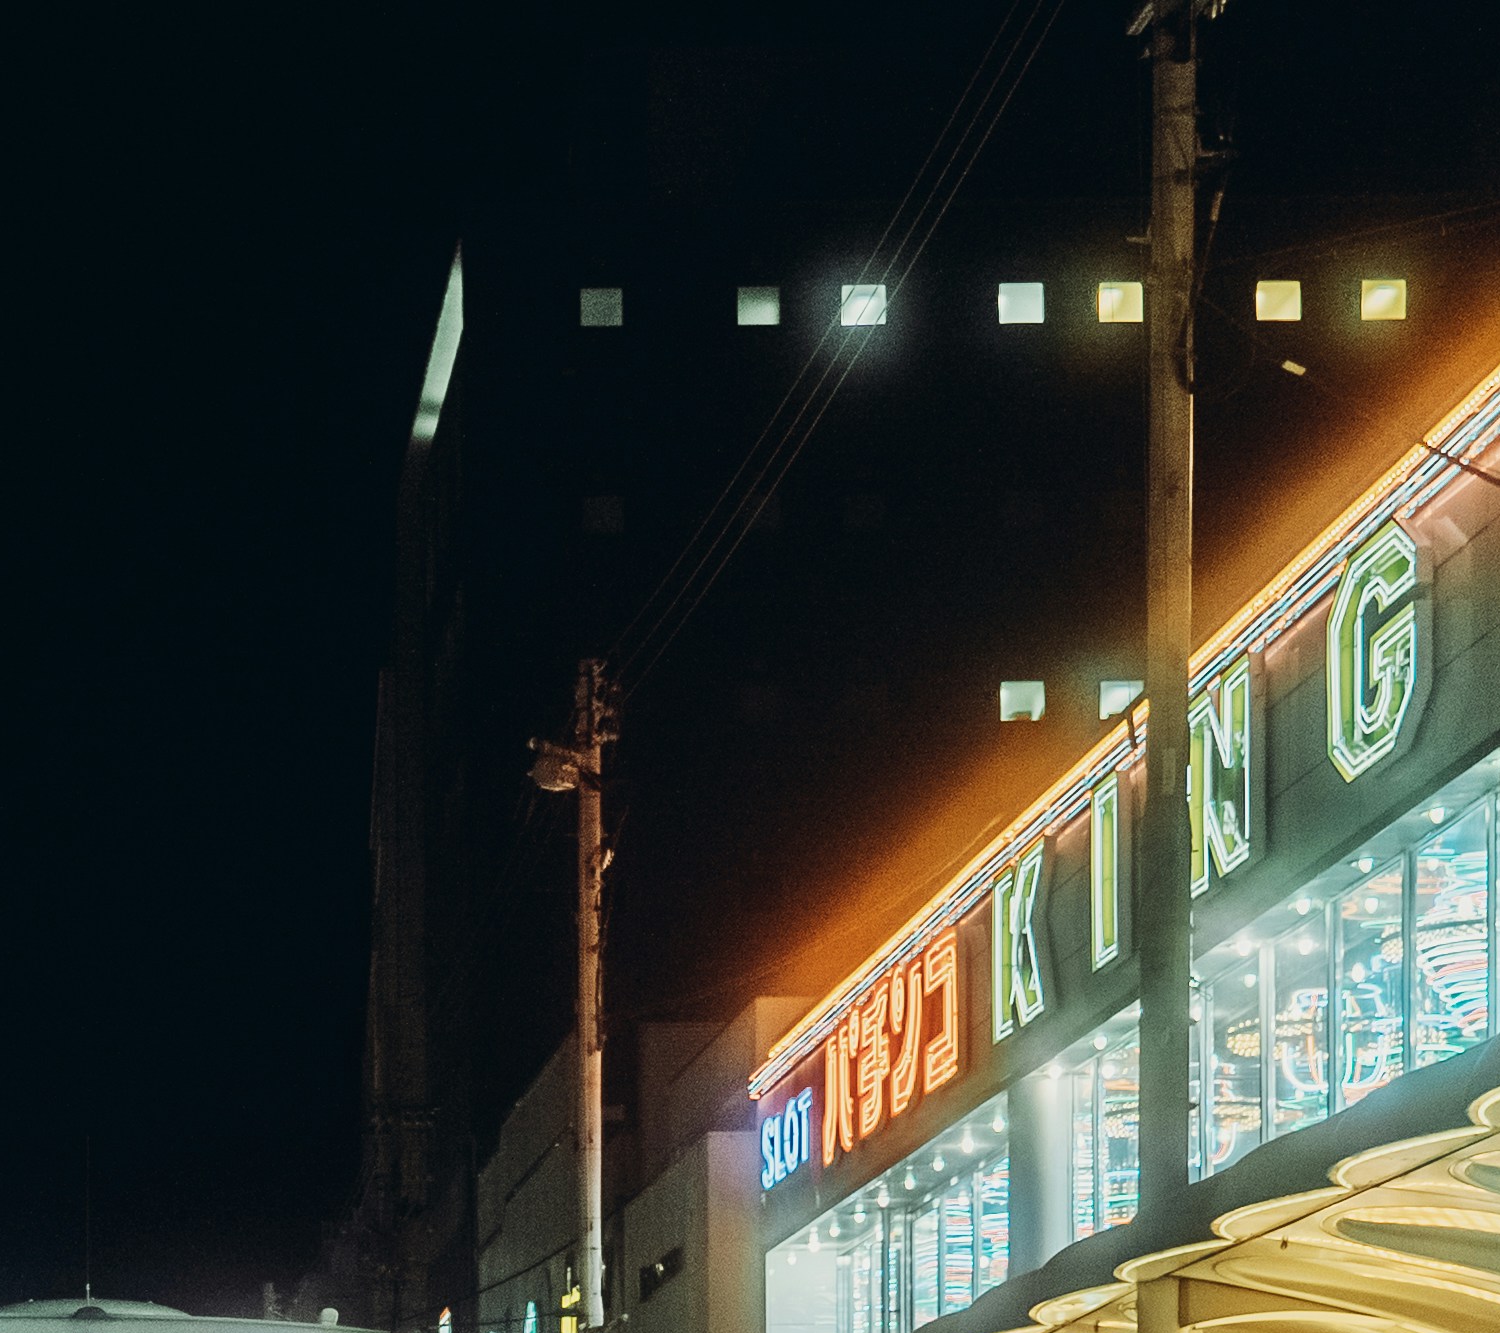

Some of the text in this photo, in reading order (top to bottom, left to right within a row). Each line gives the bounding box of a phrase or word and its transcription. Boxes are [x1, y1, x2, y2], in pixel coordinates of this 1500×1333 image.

[761, 1087, 814, 1191] SLOT
[822, 926, 960, 1170] パチンコ
